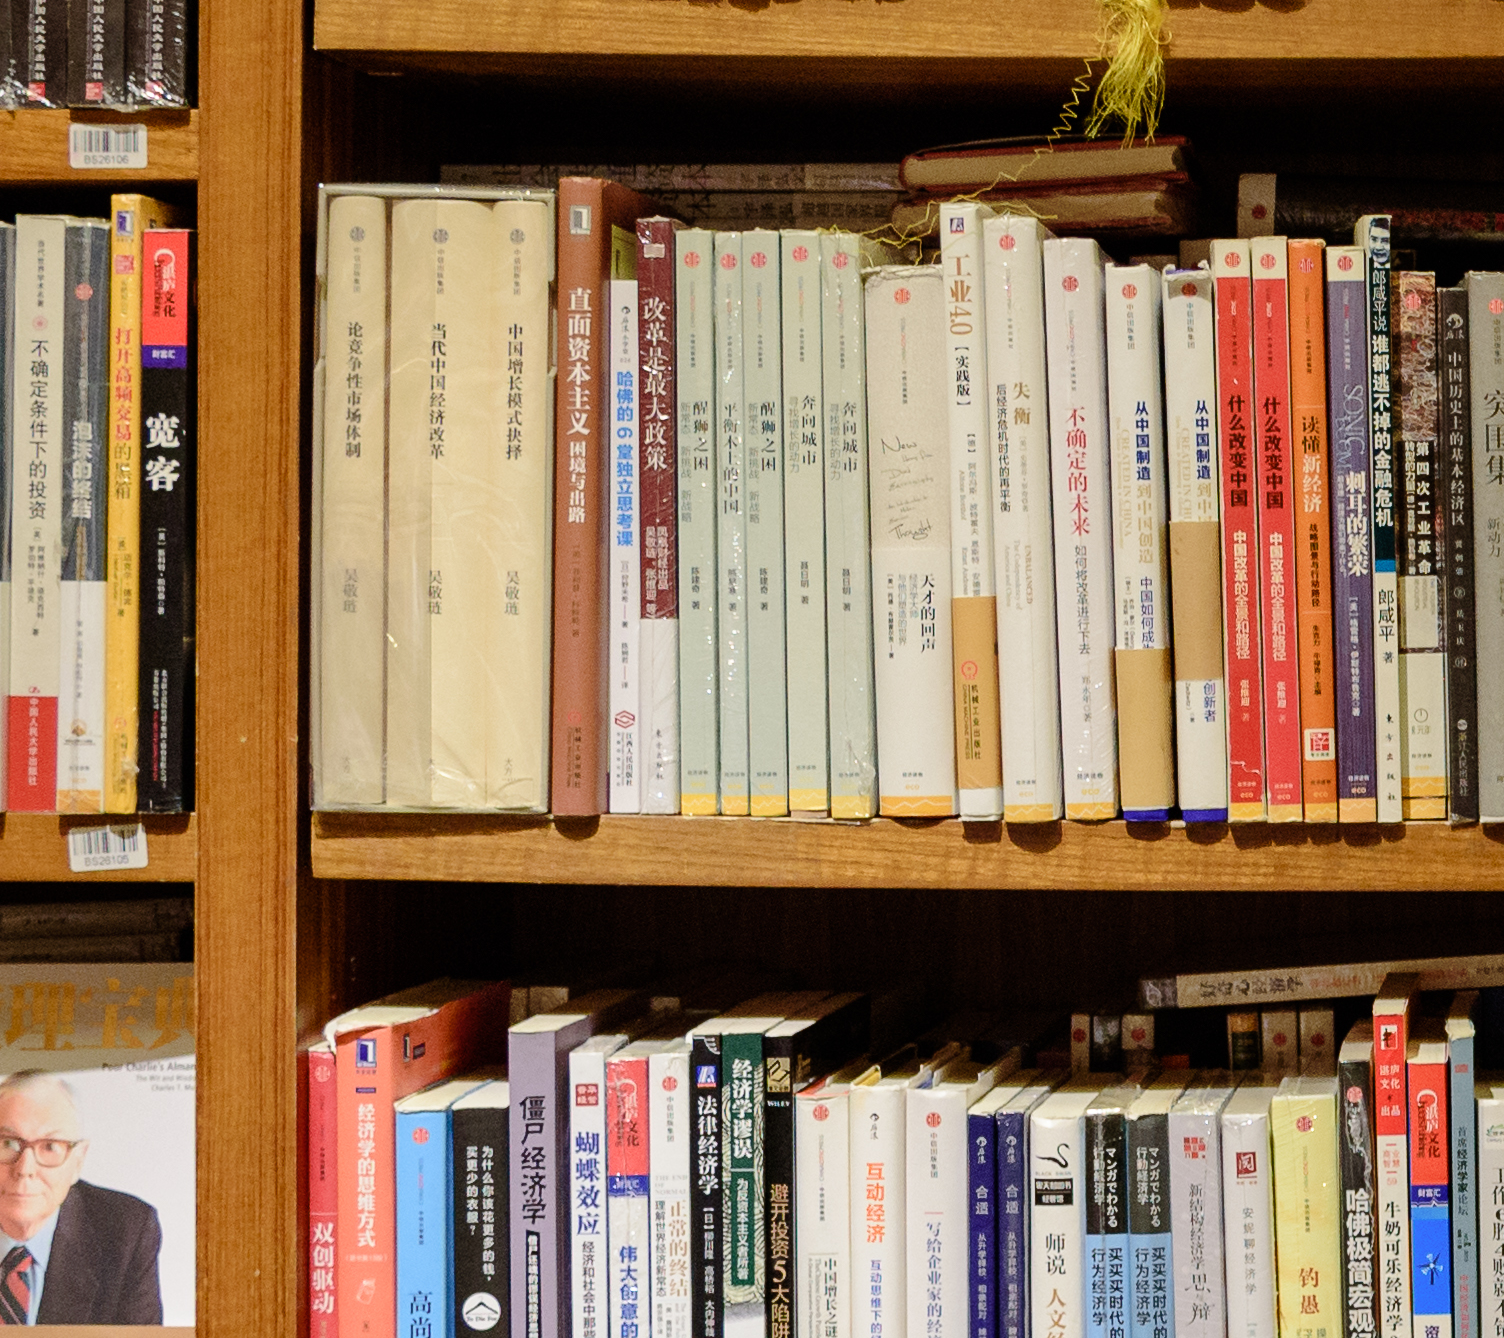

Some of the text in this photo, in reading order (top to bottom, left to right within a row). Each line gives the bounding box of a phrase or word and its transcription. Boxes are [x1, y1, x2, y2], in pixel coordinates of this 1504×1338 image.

[345, 322, 364, 459] 论竞争性市场体制
[429, 323, 447, 459] 当代中国经济改革
[507, 323, 524, 461] 中国增长模式抉择
[567, 287, 592, 435] 直面资本主义
[145, 412, 180, 492] 宽客
[568, 440, 587, 524] 困境与出路
[1064, 405, 1089, 536] 不确定的未来
[1227, 393, 1247, 508] 什么改变中国
[920, 573, 937, 653] 天才的回声
[1377, 588, 1395, 643] 郎咸平
[520, 1095, 545, 1225] 僵尸经济学
[698, 1095, 717, 1193] 法律经济学
[731, 1060, 752, 1157] 经济学谬误
[576, 1132, 600, 1237] 蝴蝶效应
[867, 1163, 884, 1244] 互动经济
